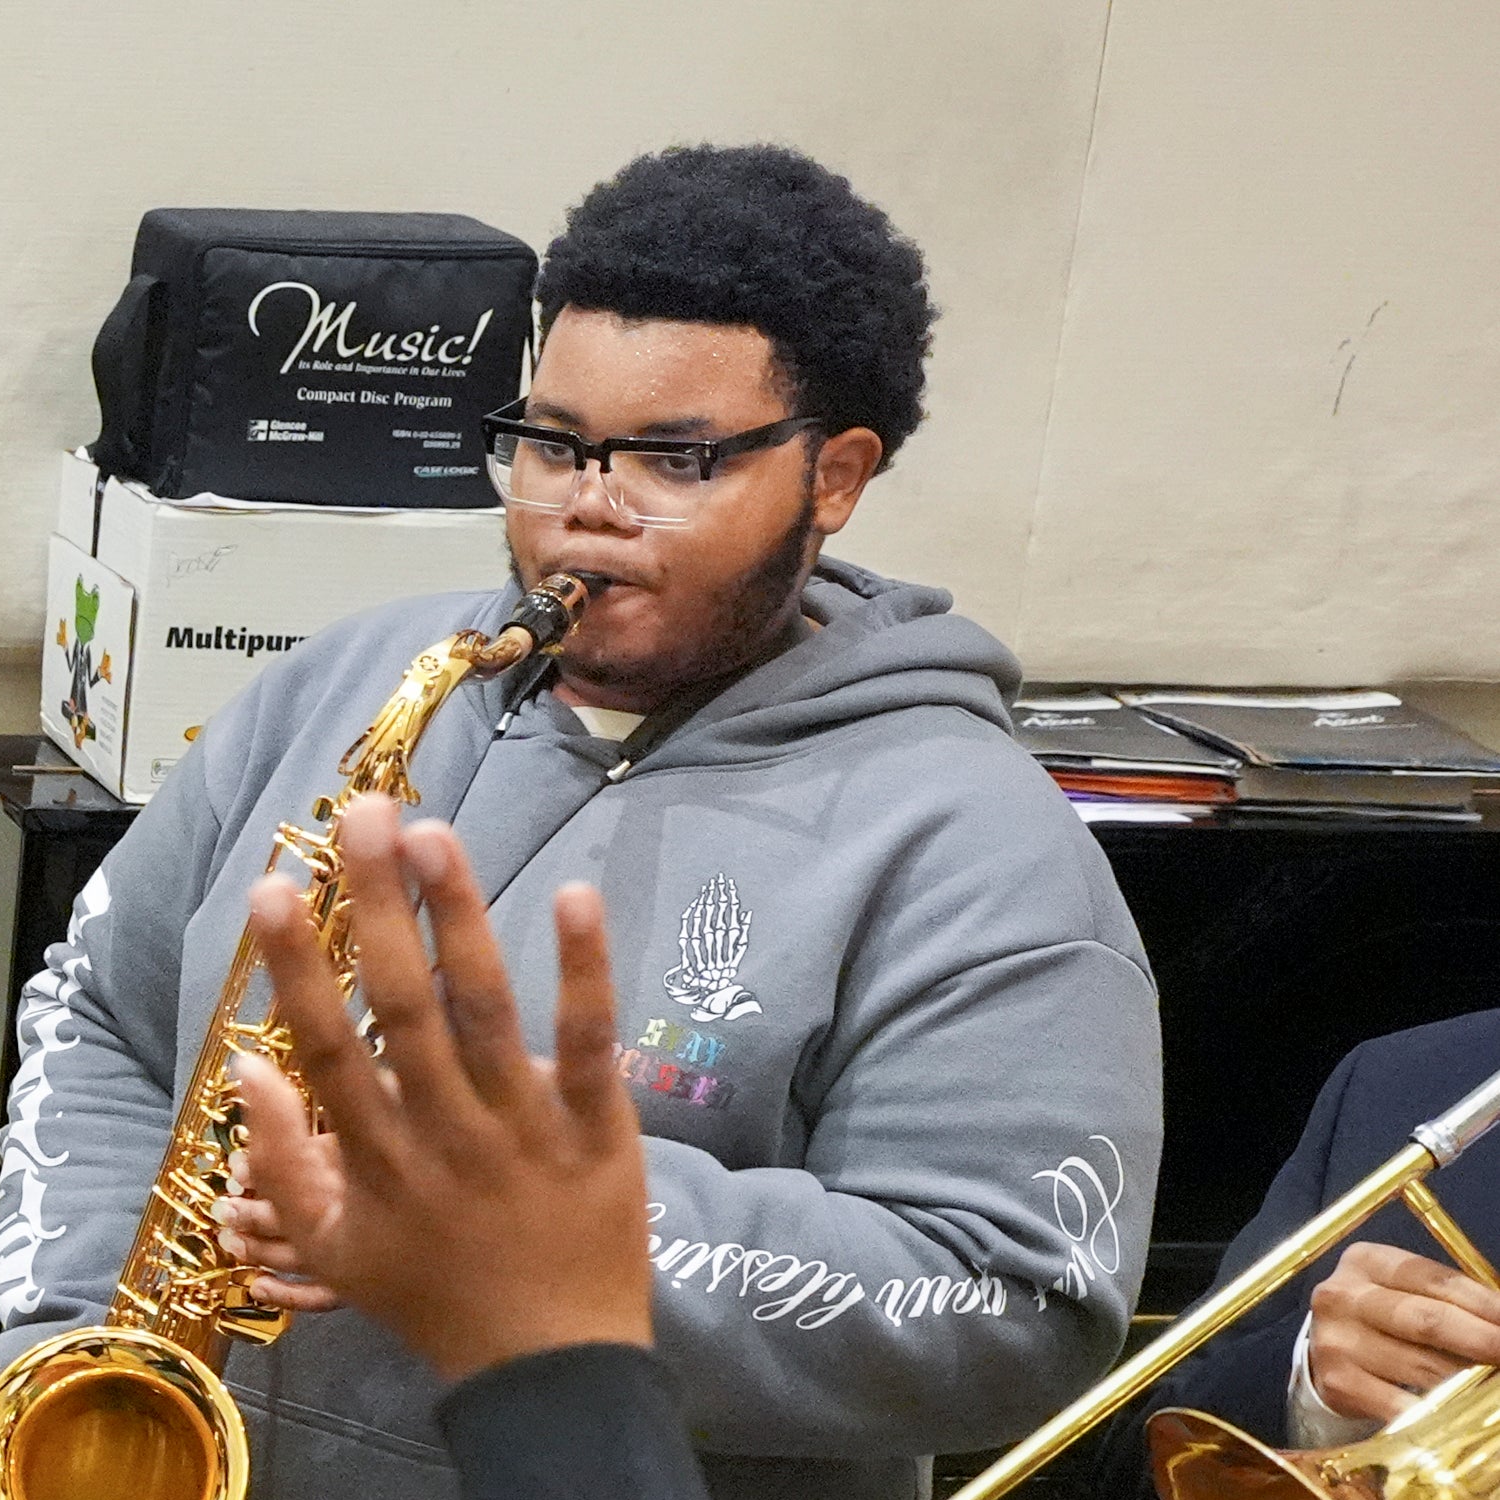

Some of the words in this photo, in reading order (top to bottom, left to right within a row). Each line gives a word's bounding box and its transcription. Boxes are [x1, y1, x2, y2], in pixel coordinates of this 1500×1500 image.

[248, 281, 494, 375] Music!
[298, 360, 311, 370] Its
[312, 360, 334, 371] Role
[334, 361, 354, 372] and
[355, 362, 408, 375] Importance
[409, 366, 420, 376] in
[421, 366, 440, 376] Our
[296, 386, 356, 405] Compact
[360, 389, 390, 405] Disc
[393, 391, 453, 410] Program
[270, 419, 307, 431] Glencoe
[268, 430, 324, 441] McGraw-Hill
[165, 626, 314, 658] Multipur
